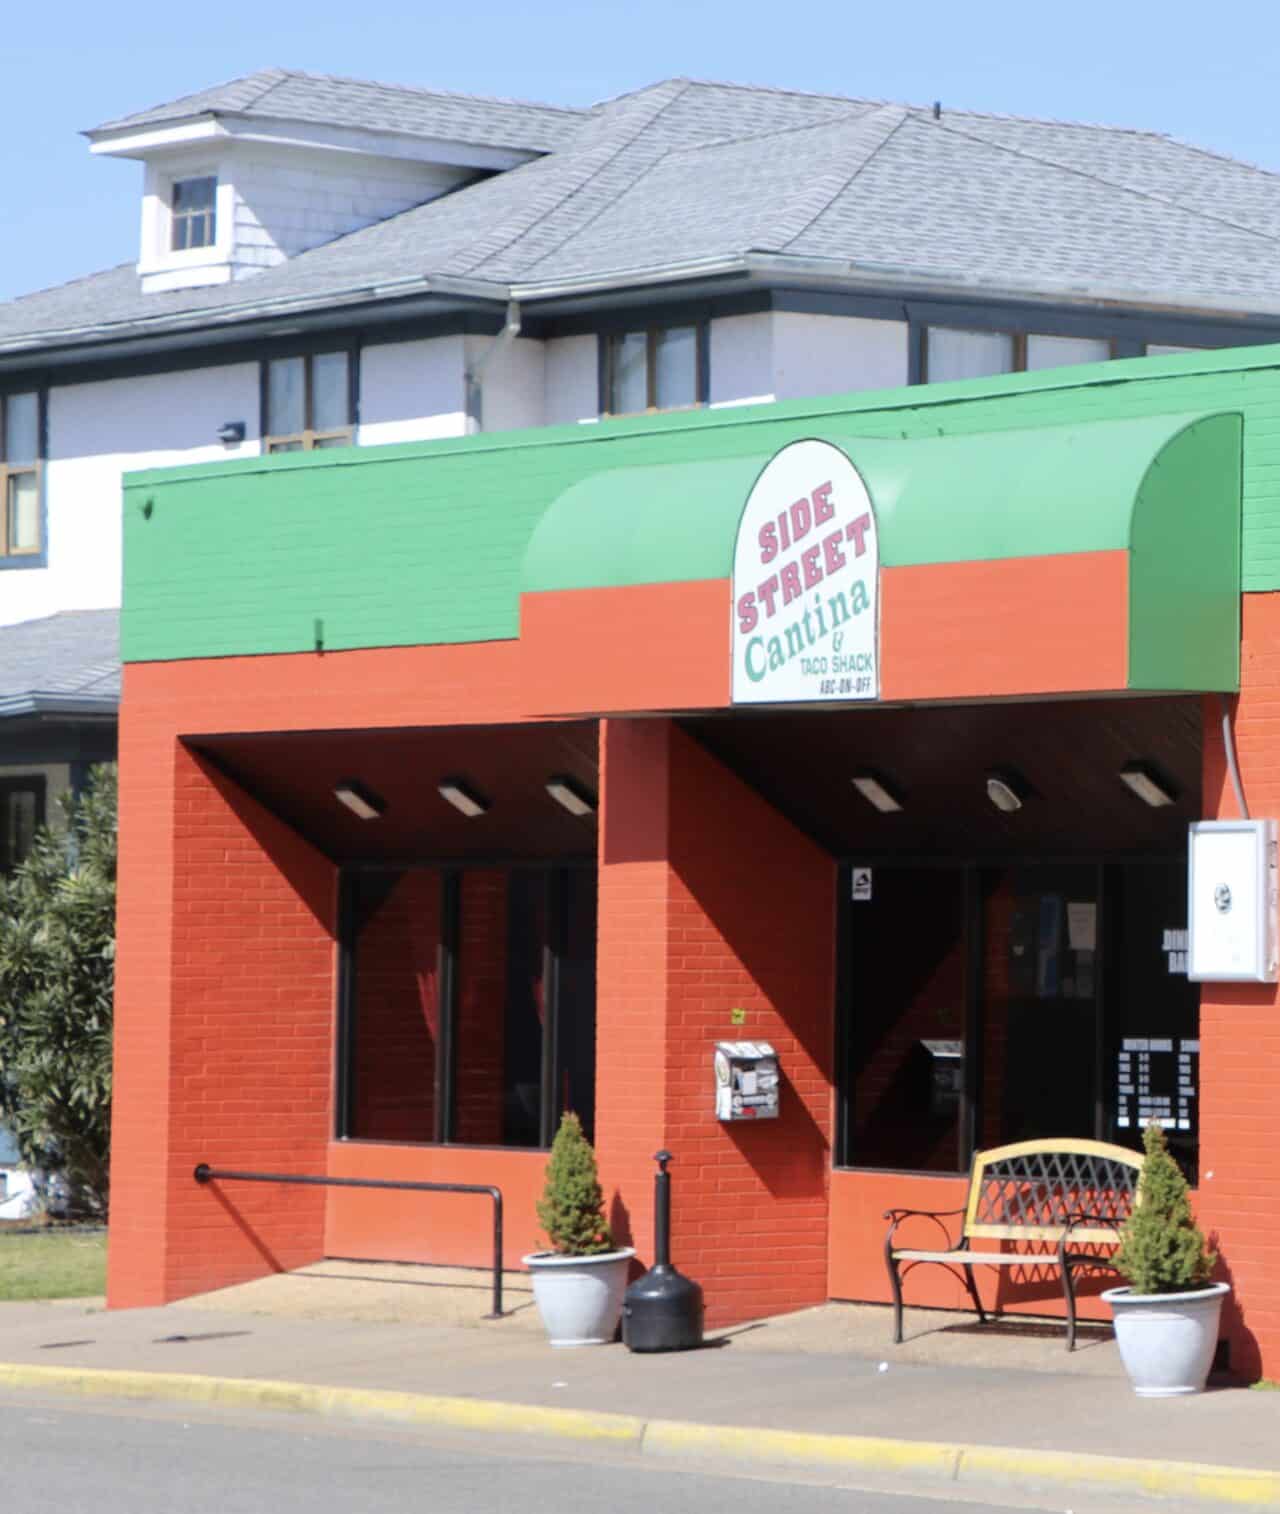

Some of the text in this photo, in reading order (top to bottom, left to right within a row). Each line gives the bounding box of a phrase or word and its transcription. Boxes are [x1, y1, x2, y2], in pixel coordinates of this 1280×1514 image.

[758, 480, 836, 565] SIDE
[737, 512, 871, 635] STREET
[744, 579, 871, 683] Cantina
[800, 652, 873, 676] TACO SHACK
